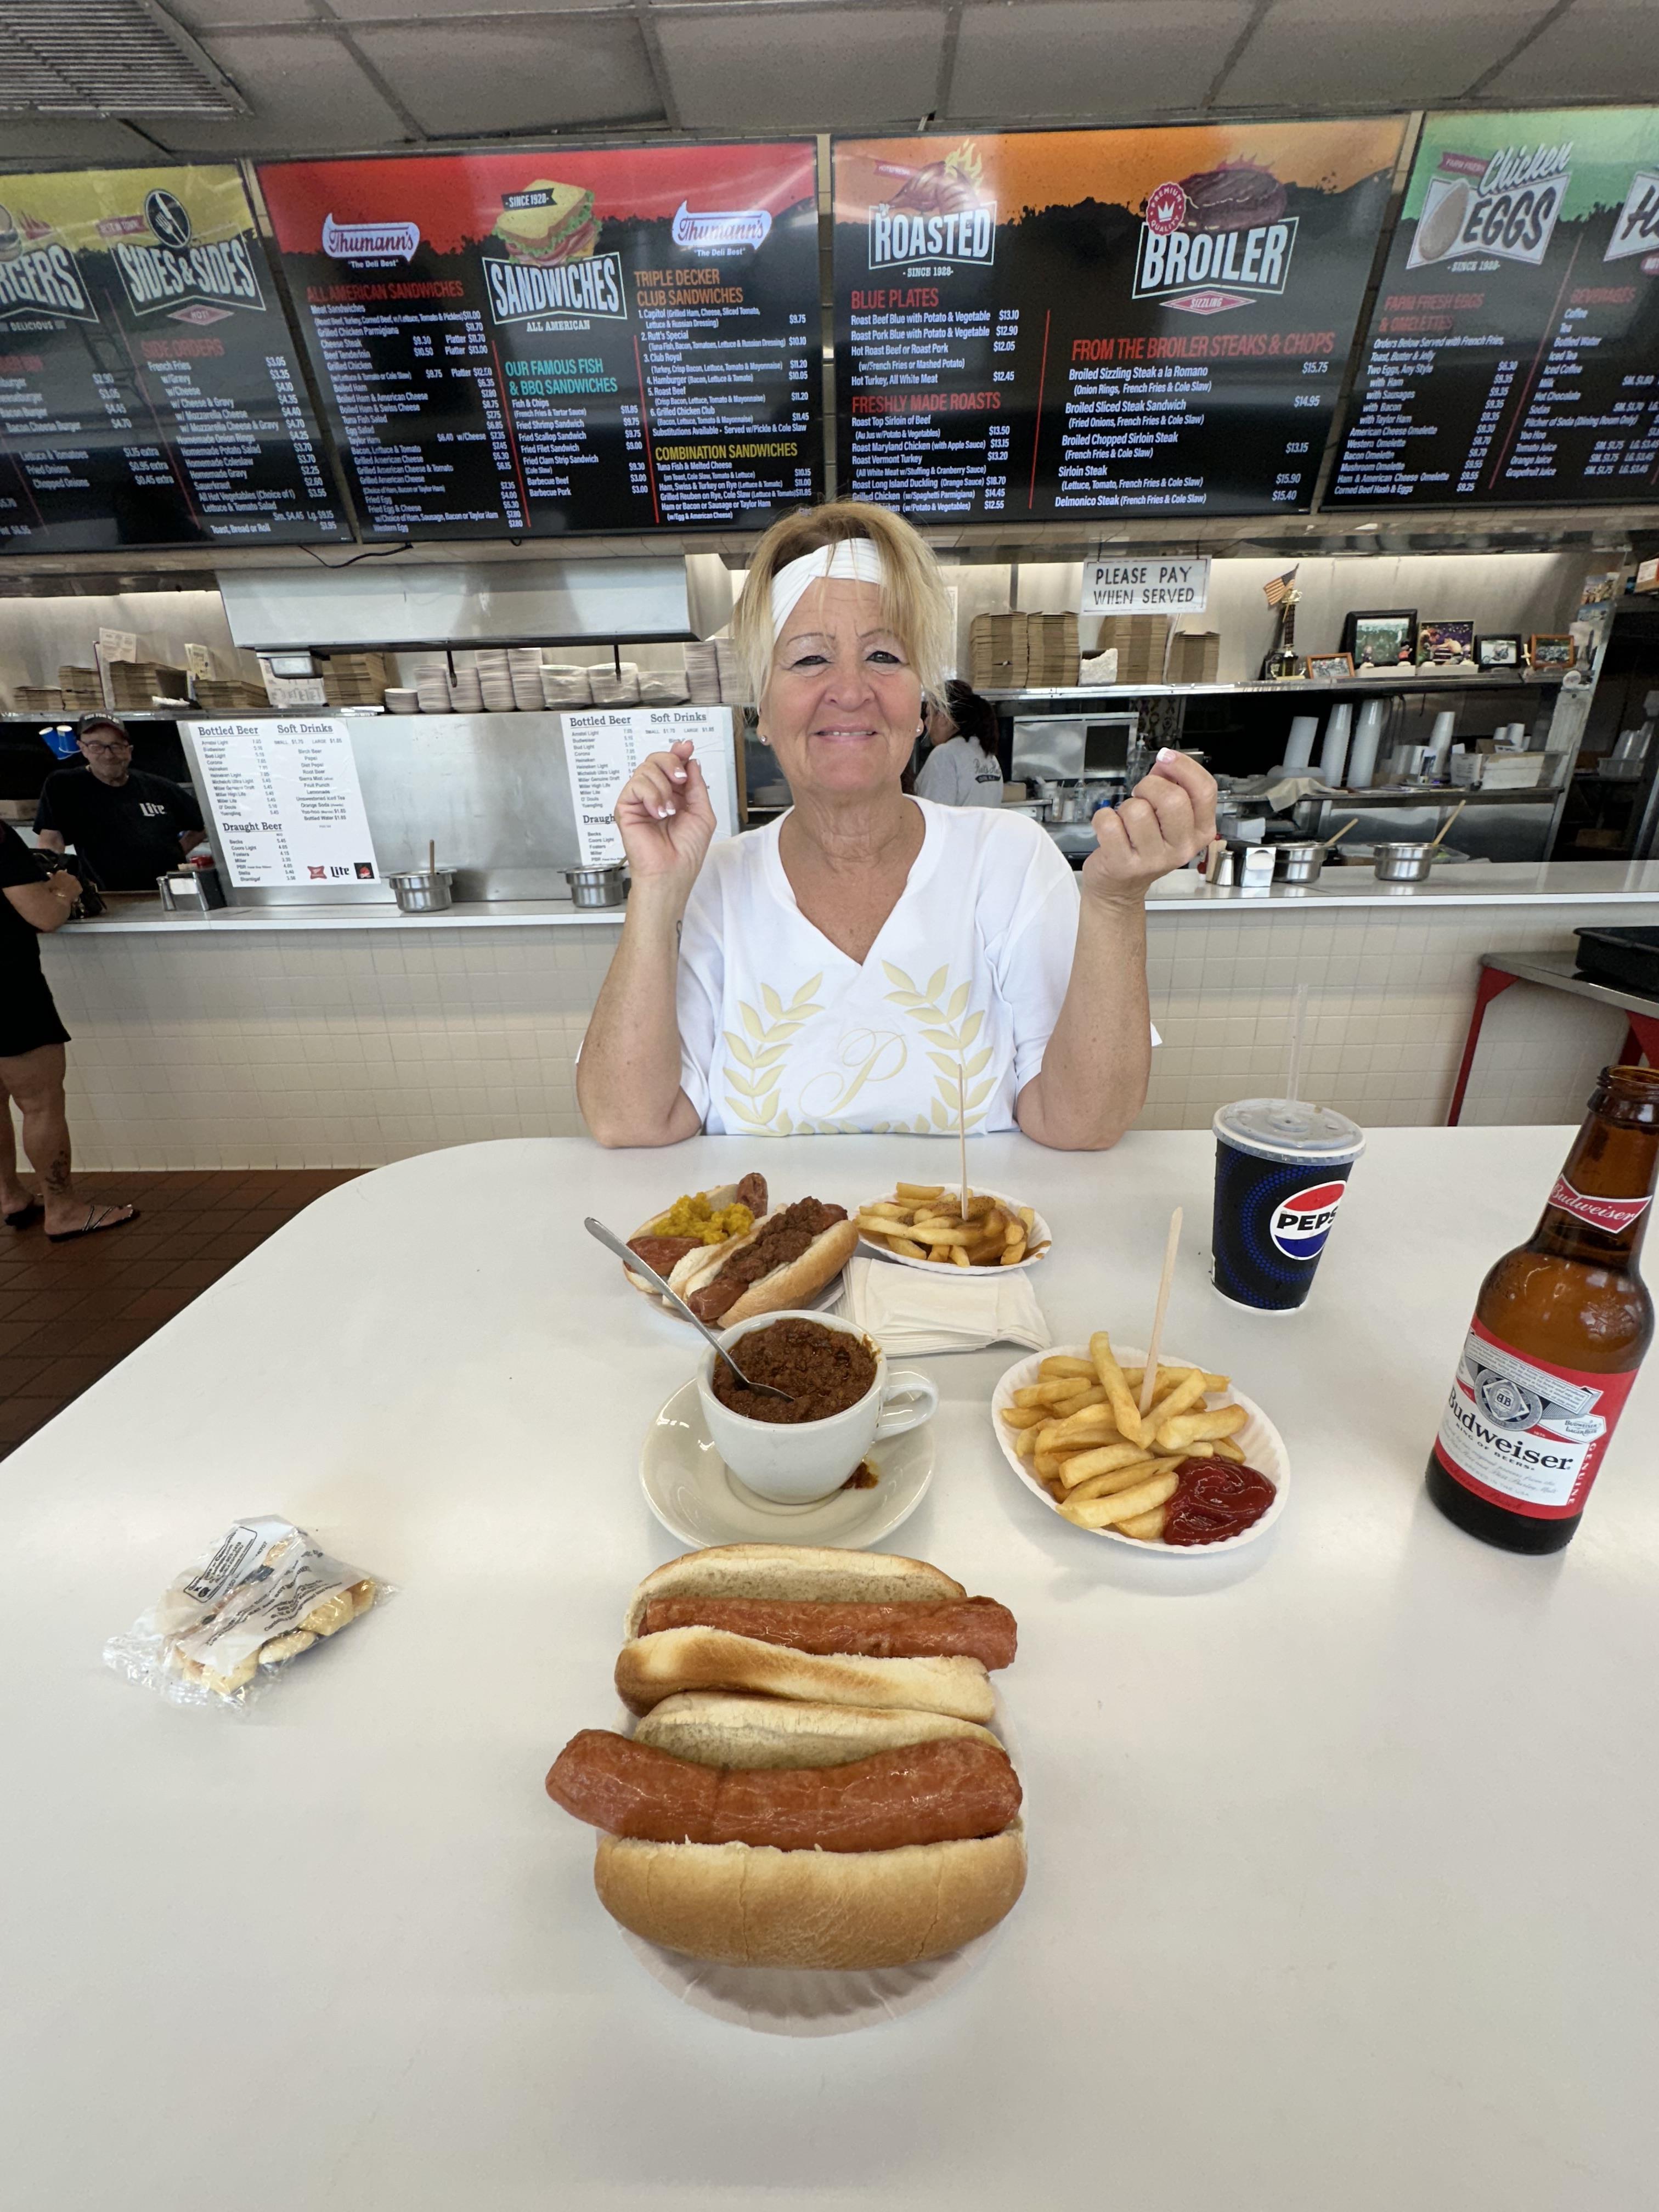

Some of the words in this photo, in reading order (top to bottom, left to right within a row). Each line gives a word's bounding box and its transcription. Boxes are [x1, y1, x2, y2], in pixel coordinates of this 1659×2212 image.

[1479, 142, 1574, 198] Chicken
[1152, 188, 1182, 207] PREMIUM
[1152, 216, 1179, 232] QUALITY
[1463, 187, 1556, 251] EGGS
[678, 217, 763, 241] Thumann's
[874, 208, 991, 262] ROASTED
[330, 230, 413, 253] Thumann's
[1141, 224, 1288, 289] BROILER
[634, 270, 674, 287] TRIPLE
[675, 269, 720, 285] DECKER
[389, 281, 464, 299] SANDWICHES
[493, 258, 619, 316] SANDWICHES
[637, 290, 666, 307] CLUB
[669, 287, 743, 306] SANDWICHES
[851, 290, 885, 309] BLUE
[889, 288, 939, 308] PLATES
[1189, 297, 1223, 308] SIZZLING
[851, 315, 871, 325] Roast
[872, 314, 889, 325] Beef
[890, 313, 905, 324] Blue
[906, 312, 922, 323] with
[923, 313, 946, 323] Potato
[948, 312, 953, 322] &
[955, 310, 991, 324] Vegetable
[527, 321, 542, 332] ALL
[545, 320, 590, 331] AMERICAN
[851, 330, 871, 341] Roast
[872, 329, 889, 340] Pork
[890, 329, 905, 339] Blue
[906, 329, 922, 338] with
[923, 328, 946, 338] Potato
[947, 328, 953, 338] &
[955, 326, 990, 340] Vegetable
[173, 339, 224, 356] ORDERS
[851, 346, 864, 356] Hot
[865, 346, 884, 356] Roast
[885, 344, 902, 355] Beef
[911, 344, 931, 354] Roast
[932, 343, 949, 353] Pork
[1071, 338, 1115, 361] FROM
[1117, 337, 1146, 359] THE
[1147, 335, 1209, 359] BROILER
[1211, 335, 1267, 357] STEAKS
[1268, 334, 1281, 354] &
[1283, 332, 1335, 354] CHOPS
[644, 354, 650, 363] 3.
[650, 353, 664, 362] Club
[665, 353, 682, 363] Royal
[505, 361, 529, 376] OUR
[531, 359, 575, 375] FAMOUS
[578, 358, 603, 374] FISH
[1069, 368, 1098, 381] Broiled
[1099, 366, 1132, 381] Sizzling
[1132, 366, 1156, 379] Steak
[1158, 369, 1163, 377] a
[1164, 366, 1172, 377] la
[1173, 365, 1208, 377] Romano
[1302, 362, 1329, 374] $15.75
[851, 376, 864, 386] Hot
[865, 375, 888, 387] Turkey,
[889, 374, 899, 384] All
[900, 374, 919, 384] White
[921, 374, 938, 383] Meat
[993, 371, 1014, 382] $12.45
[509, 382, 519, 396] &
[521, 381, 545, 396] BBQ
[546, 378, 618, 394] SANDWICHES
[852, 395, 907, 413] FRESHLY
[911, 394, 947, 411] MADE
[950, 392, 1001, 410] ROASTS
[1065, 402, 1095, 414] Broiled
[1096, 400, 1120, 413] Sliced
[1121, 400, 1145, 412] Steak
[1146, 399, 1186, 411] Sandwich
[1294, 395, 1321, 408] $14.95
[851, 417, 871, 426] Roast
[872, 416, 884, 427] Top
[885, 416, 906, 426] Sirloin
[907, 415, 915, 425] of
[916, 414, 931, 425] Beef
[653, 427, 691, 437] Substitutions
[692, 426, 719, 435] Available
[724, 425, 745, 433] Served
[792, 423, 806, 431] Slaw
[989, 426, 1010, 436] $13.50
[851, 443, 871, 452] Roast
[872, 442, 902, 453] Maryland
[904, 441, 930, 450] Chicken
[1062, 434, 1091, 446] Broiled
[1092, 433, 1127, 447] Chopped
[1128, 432, 1154, 444] Sirloin
[1155, 431, 1178, 443] Steak
[523, 456, 538, 465] Fried
[555, 456, 569, 465] Strip
[570, 454, 599, 463] Sandwich
[655, 445, 726, 461] COMBINATION
[729, 442, 797, 459] SANDWICHES
[852, 456, 871, 464] Roast
[872, 455, 900, 464] Vermont
[900, 454, 922, 465] Turkey
[988, 451, 1008, 461] $13.20
[1058, 466, 1084, 477] Sirloin
[1085, 465, 1108, 476] Steak
[1055, 495, 1096, 507] Delmonico
[1097, 494, 1120, 506] Steak
[1096, 568, 1147, 585] PLEASE
[1159, 566, 1192, 583] PAY
[1094, 589, 1133, 605] WHEN
[1142, 588, 1194, 603] SERVED
[569, 716, 605, 726] Bottled
[609, 715, 631, 725] Beer
[650, 713, 671, 723] Soft
[674, 712, 707, 722] Drinks
[198, 726, 234, 736] Bottled
[236, 726, 258, 735] Beer
[277, 724, 297, 733] Soft
[301, 724, 333, 733] Drinks
[140, 803, 167, 816] Lite
[223, 822, 259, 833] Draught
[262, 822, 283, 831] Beer
[583, 815, 616, 825] Draugh
[330, 866, 349, 878] Lite
[799, 1028, 907, 1118] P
[1552, 1182, 1637, 1221] Budweiser
[1277, 1206, 1338, 1231] PEPS
[1448, 1387, 1573, 1470] Budweiser
[1456, 1423, 1474, 1440] KING
[1567, 1443, 1596, 1505] GENUINE
